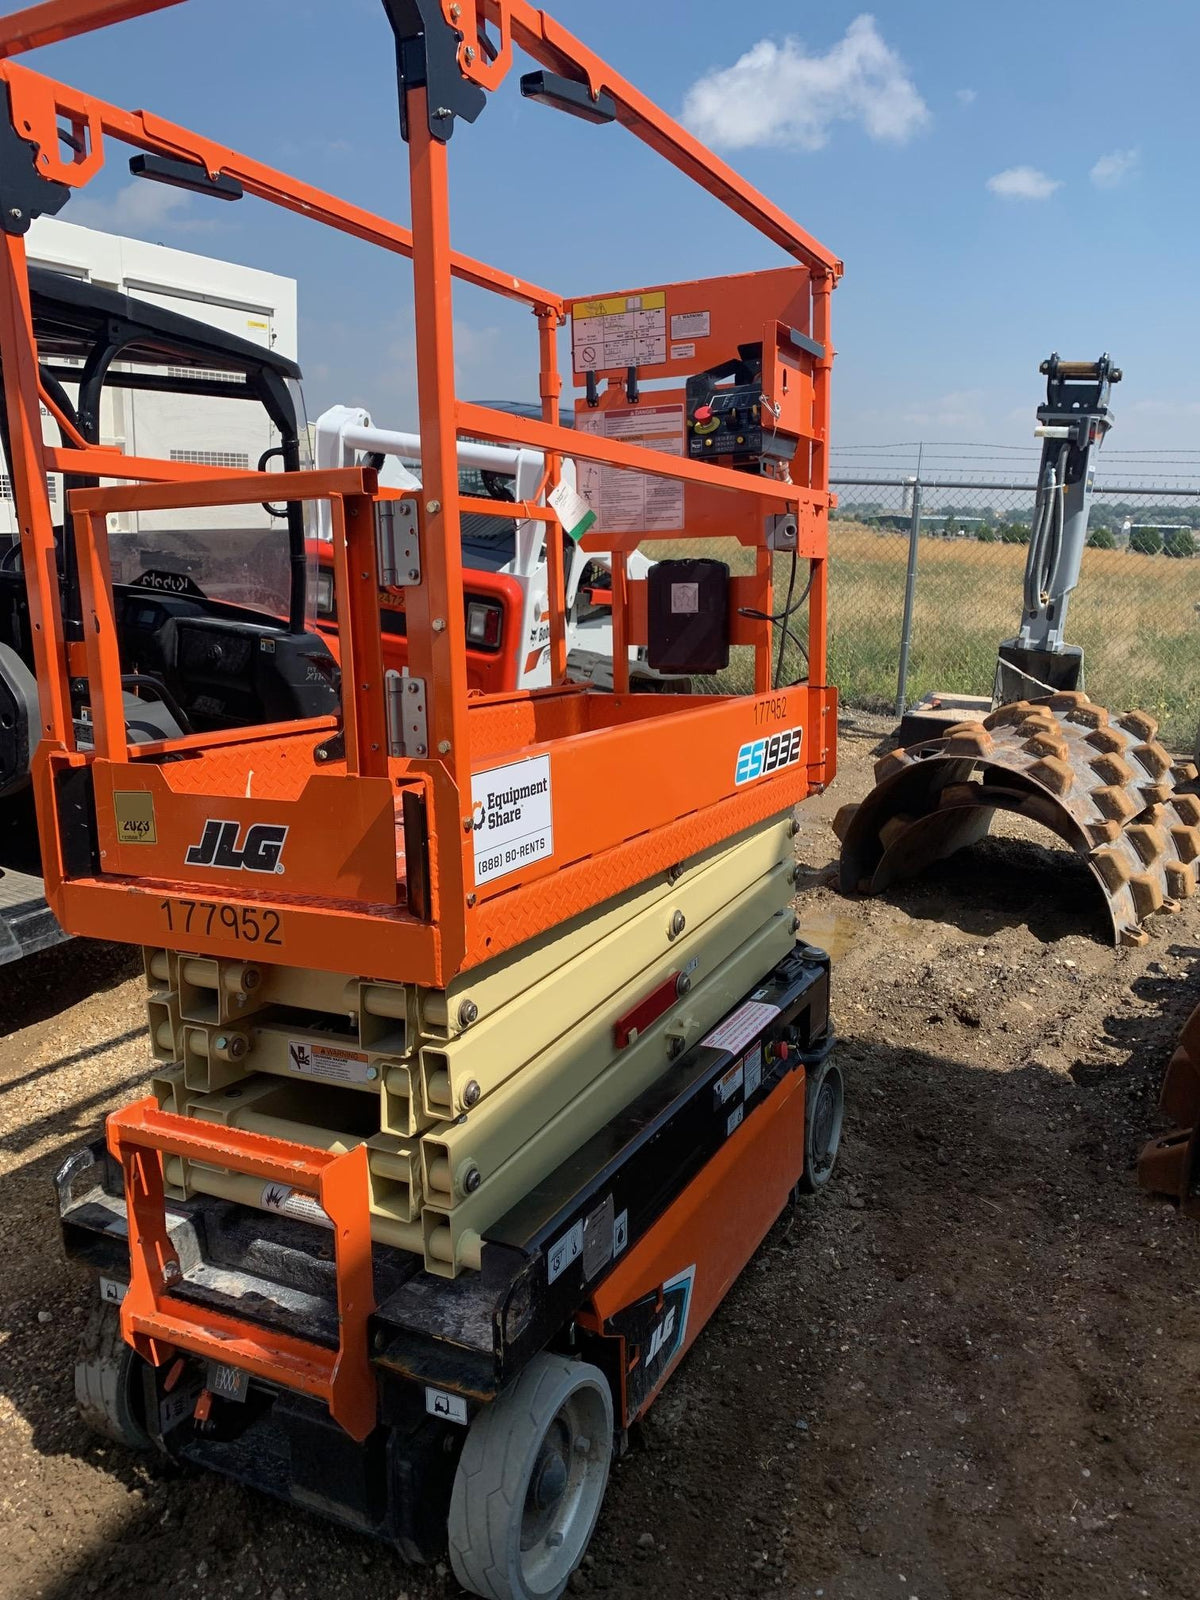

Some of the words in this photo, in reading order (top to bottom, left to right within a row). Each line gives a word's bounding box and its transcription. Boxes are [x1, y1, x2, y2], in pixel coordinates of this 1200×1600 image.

[634, 408, 657, 416] DANGER
[753, 696, 787, 725] 177952
[735, 727, 803, 785] ES1932
[487, 777, 548, 810] Equipment
[488, 807, 522, 830] Share
[478, 853, 503, 875] (888)
[160, 899, 283, 946] 177952
[327, 1048, 359, 1060] WARNING
[644, 1304, 676, 1368] JLG
